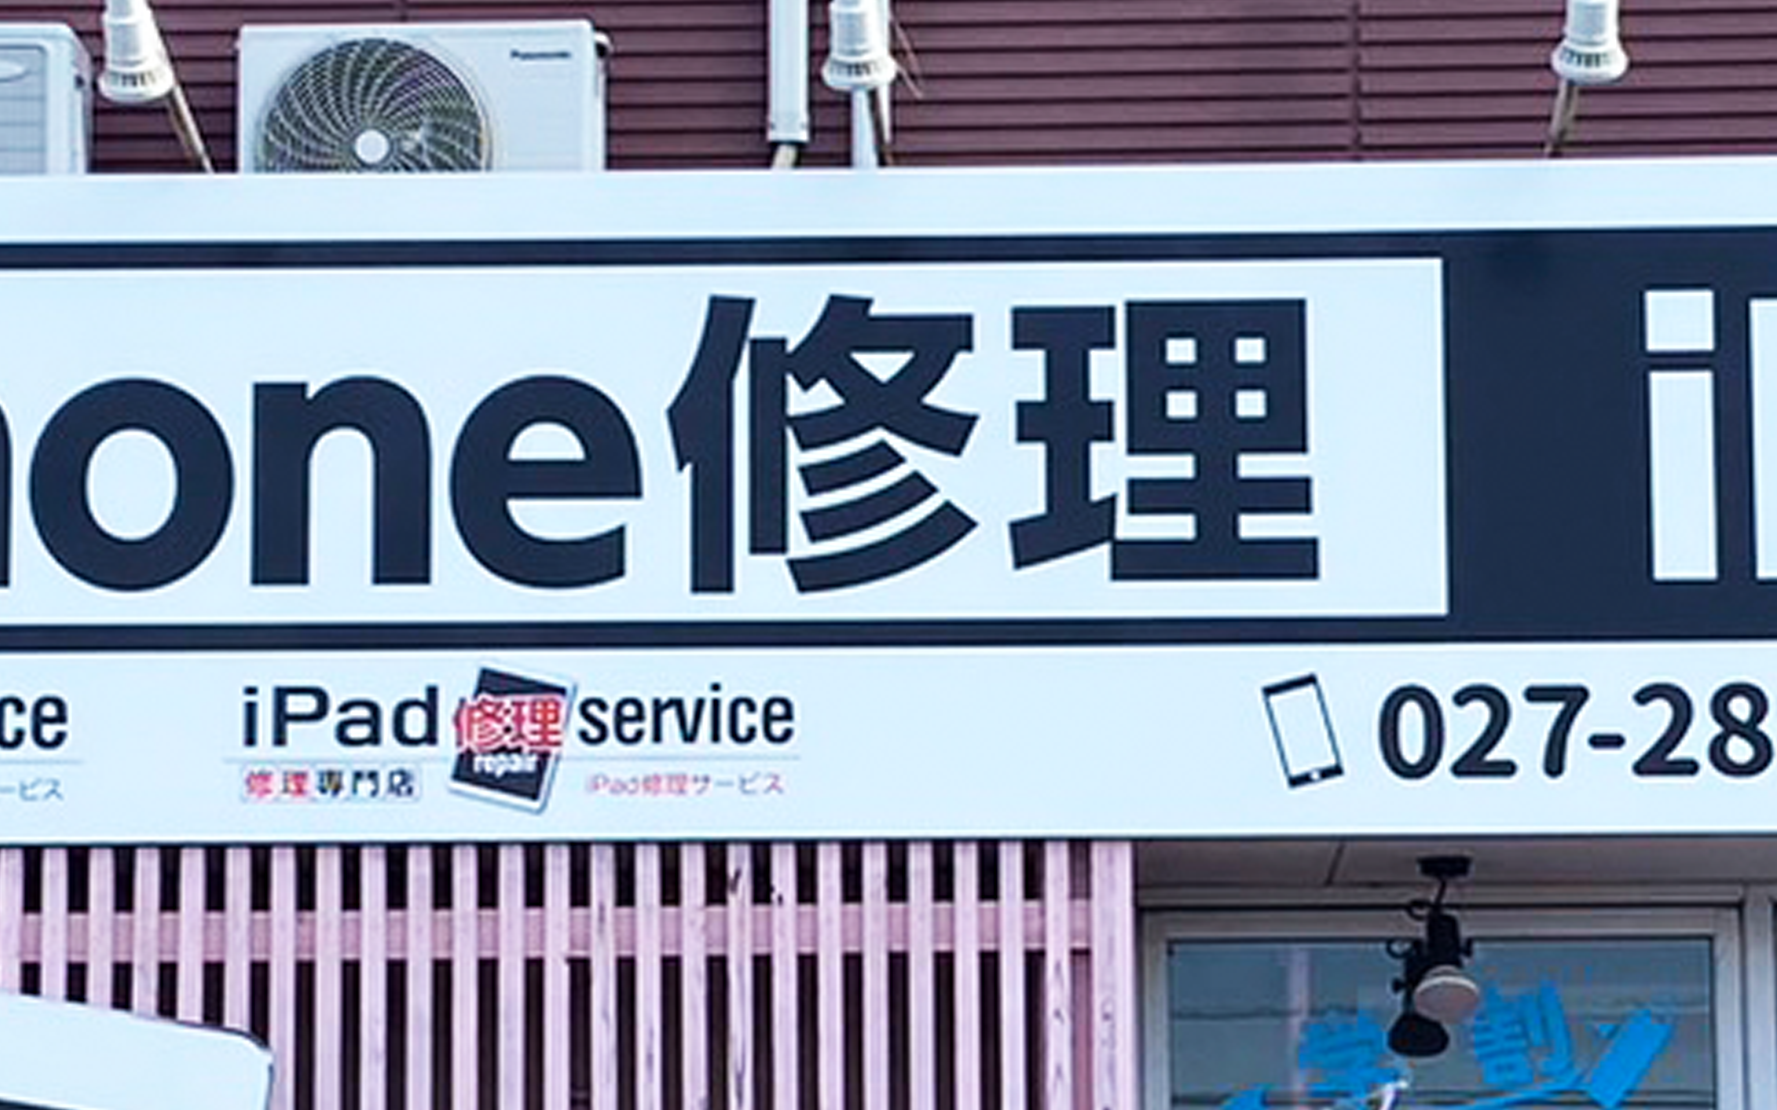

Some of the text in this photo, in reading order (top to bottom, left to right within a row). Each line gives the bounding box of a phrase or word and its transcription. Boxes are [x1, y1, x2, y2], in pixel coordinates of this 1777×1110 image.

[243, 683, 793, 752] iPad 修理 service
